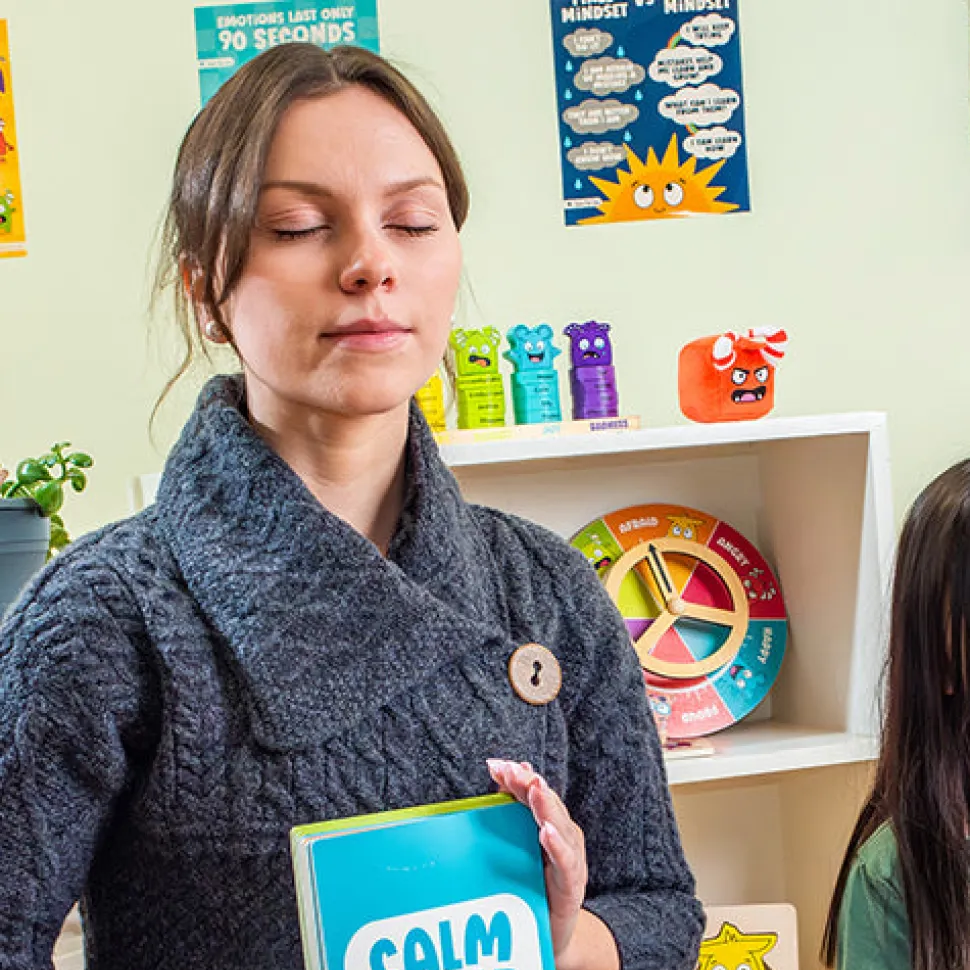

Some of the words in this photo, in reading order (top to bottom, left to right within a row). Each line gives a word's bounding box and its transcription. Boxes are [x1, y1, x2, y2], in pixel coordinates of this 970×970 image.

[217, 12, 284, 28] EMOTIONS
[288, 10, 318, 23] LAST
[321, 6, 355, 20] ONLY
[218, 30, 247, 51] 90
[254, 22, 356, 49] SECONDS
[618, 516, 659, 534] AFRAID
[717, 537, 750, 567] ANGRY
[757, 626, 773, 665] HAPPY
